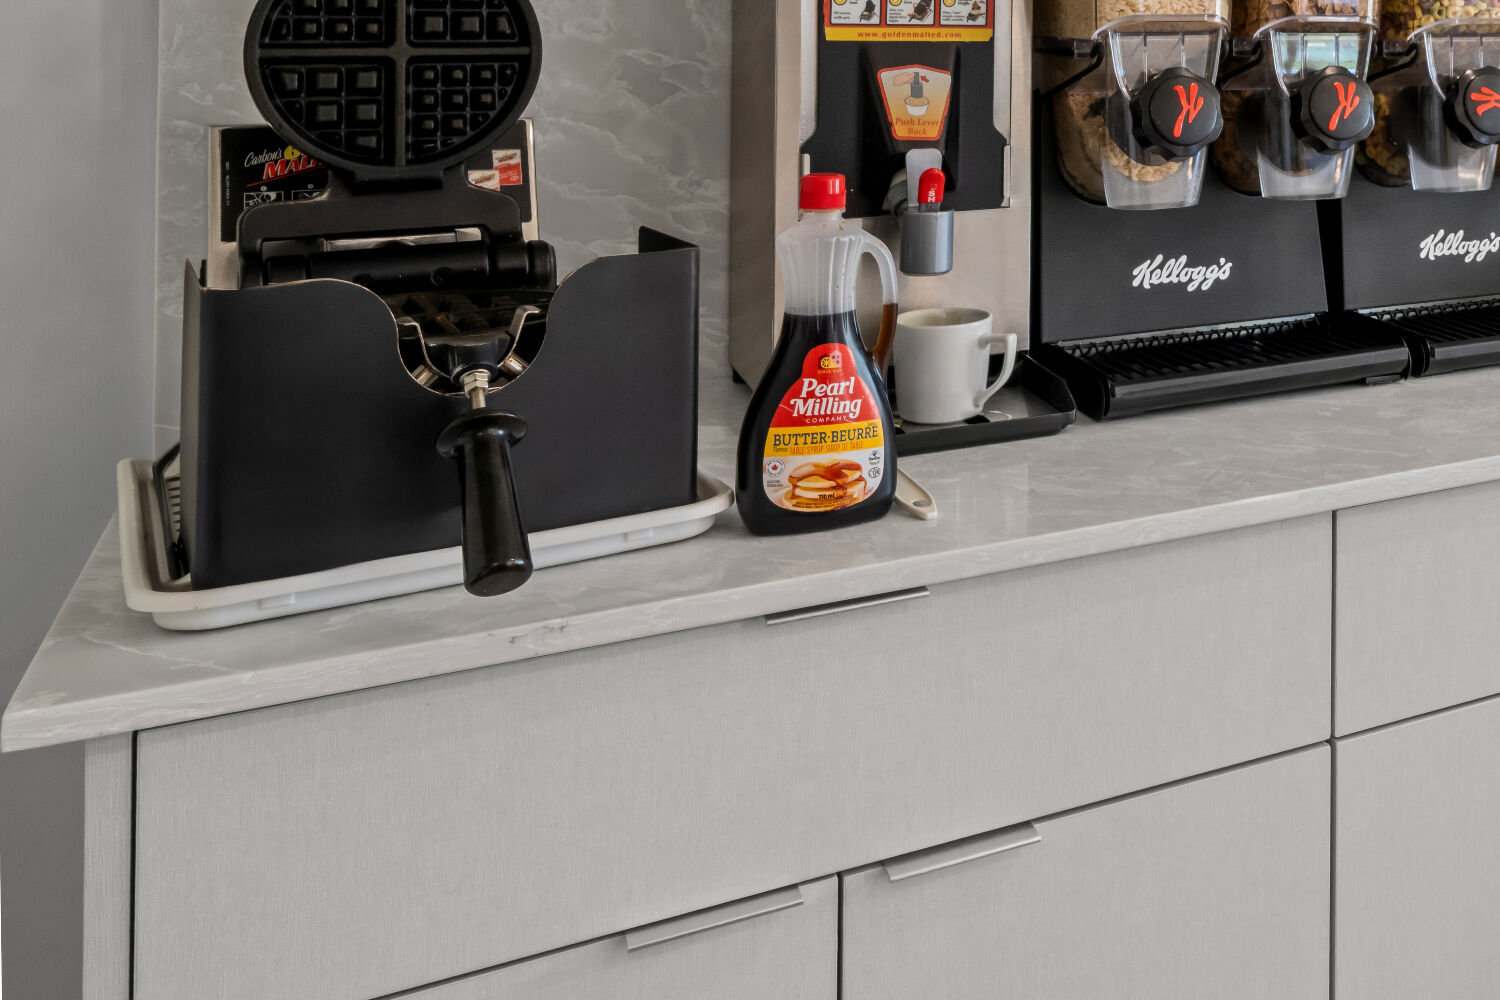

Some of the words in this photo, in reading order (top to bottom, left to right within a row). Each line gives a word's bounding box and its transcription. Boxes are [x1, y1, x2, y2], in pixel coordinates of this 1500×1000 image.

[857, 31, 962, 40] www.goldenmalted.com
[895, 117, 915, 126] Push
[917, 118, 939, 126] Lever
[907, 127, 928, 135] Back
[244, 147, 282, 168] Carbon's
[1420, 229, 1500, 263] Kellogg's
[1132, 254, 1233, 292] Kellogg's
[800, 376, 855, 398] Pearl
[789, 397, 863, 419] Milling
[806, 415, 848, 424] COMPANY
[789, 446, 805, 455] TABLE
